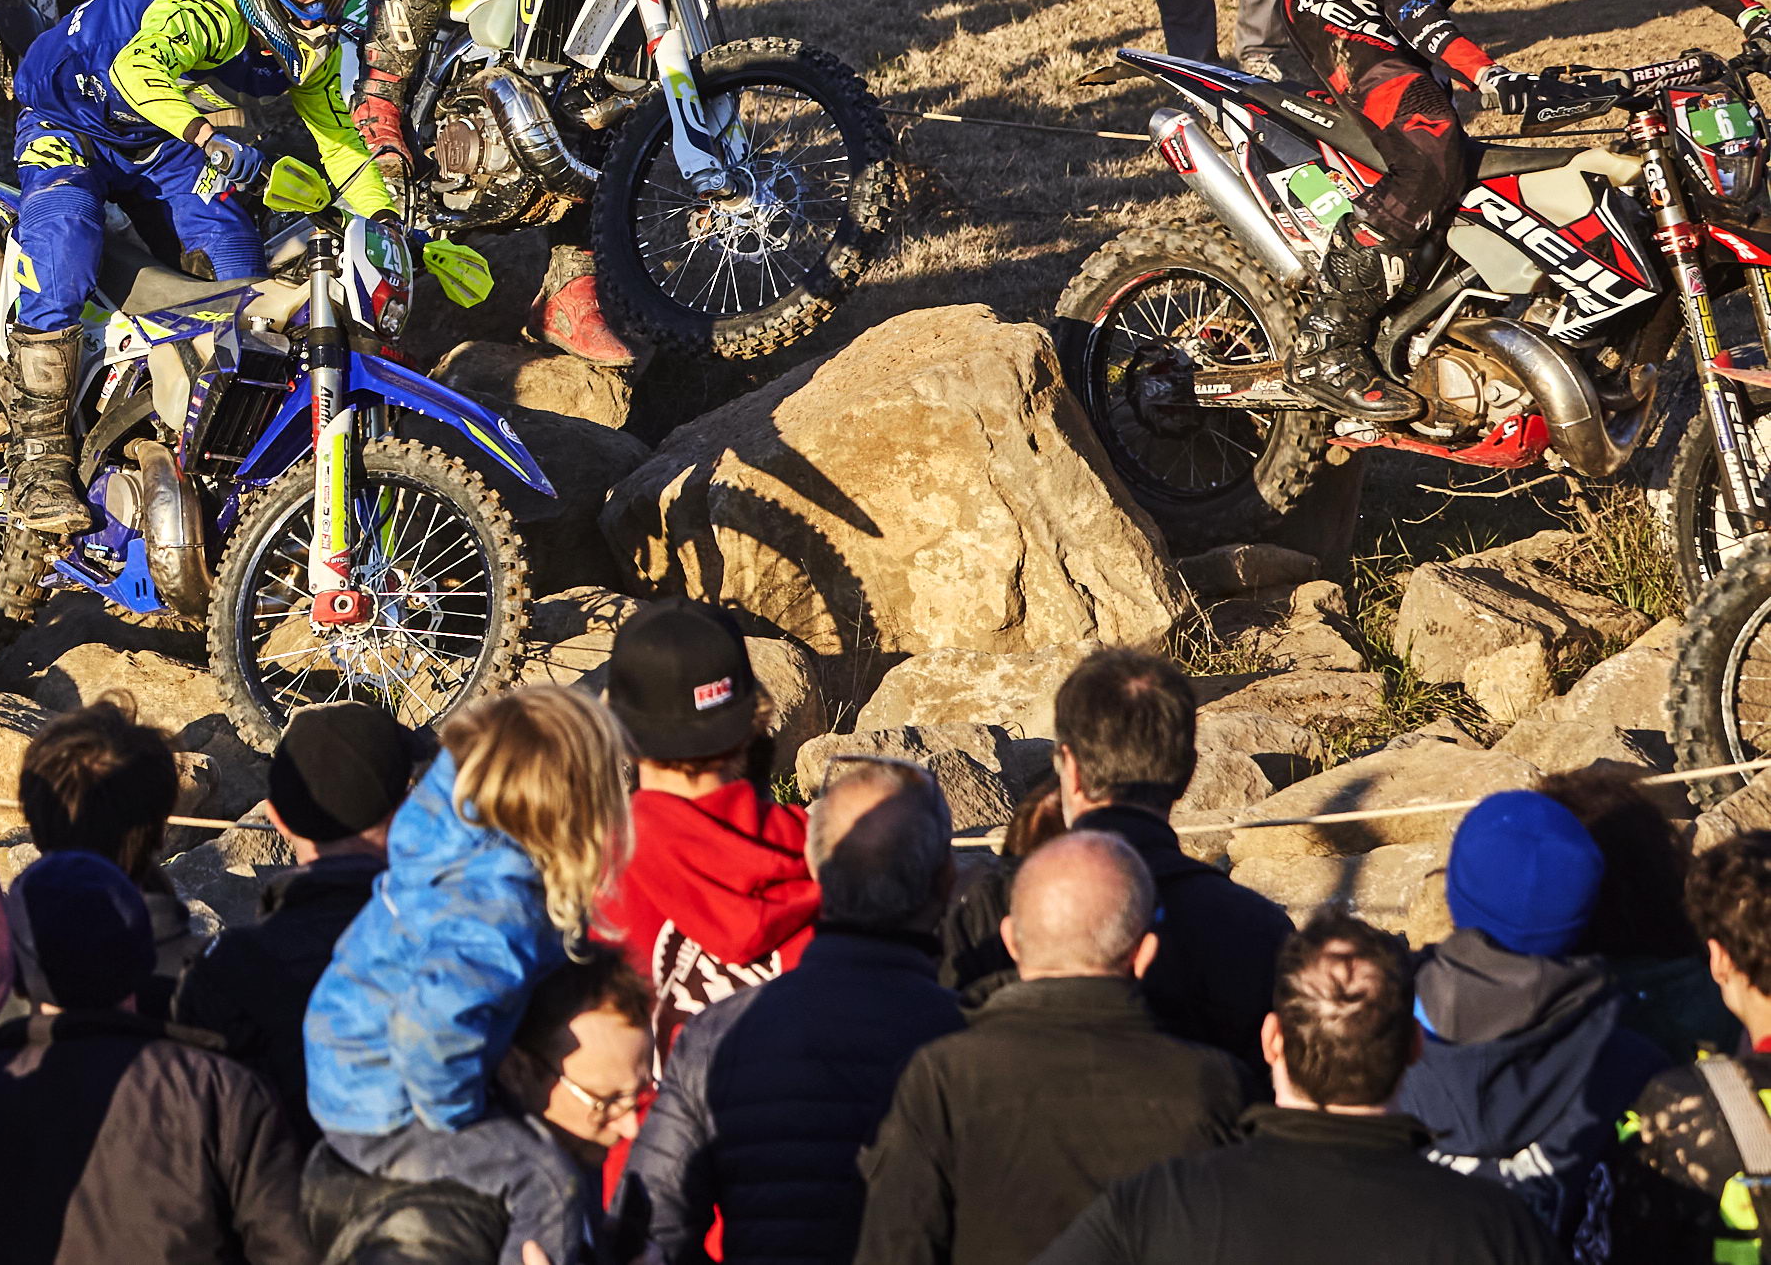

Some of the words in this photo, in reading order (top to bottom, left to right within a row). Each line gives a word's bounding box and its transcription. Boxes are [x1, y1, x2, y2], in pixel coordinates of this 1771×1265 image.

[1632, 57, 1699, 82] RENTHA
[1281, 99, 1335, 129] RIEJU
[1714, 108, 1736, 140] 6
[1684, 154, 1718, 197] RIEJU
[381, 239, 402, 273] 29
[1461, 185, 1646, 307] RIEJU
[1194, 383, 1232, 396] GALFER
[1724, 391, 1766, 508] RIEJU
